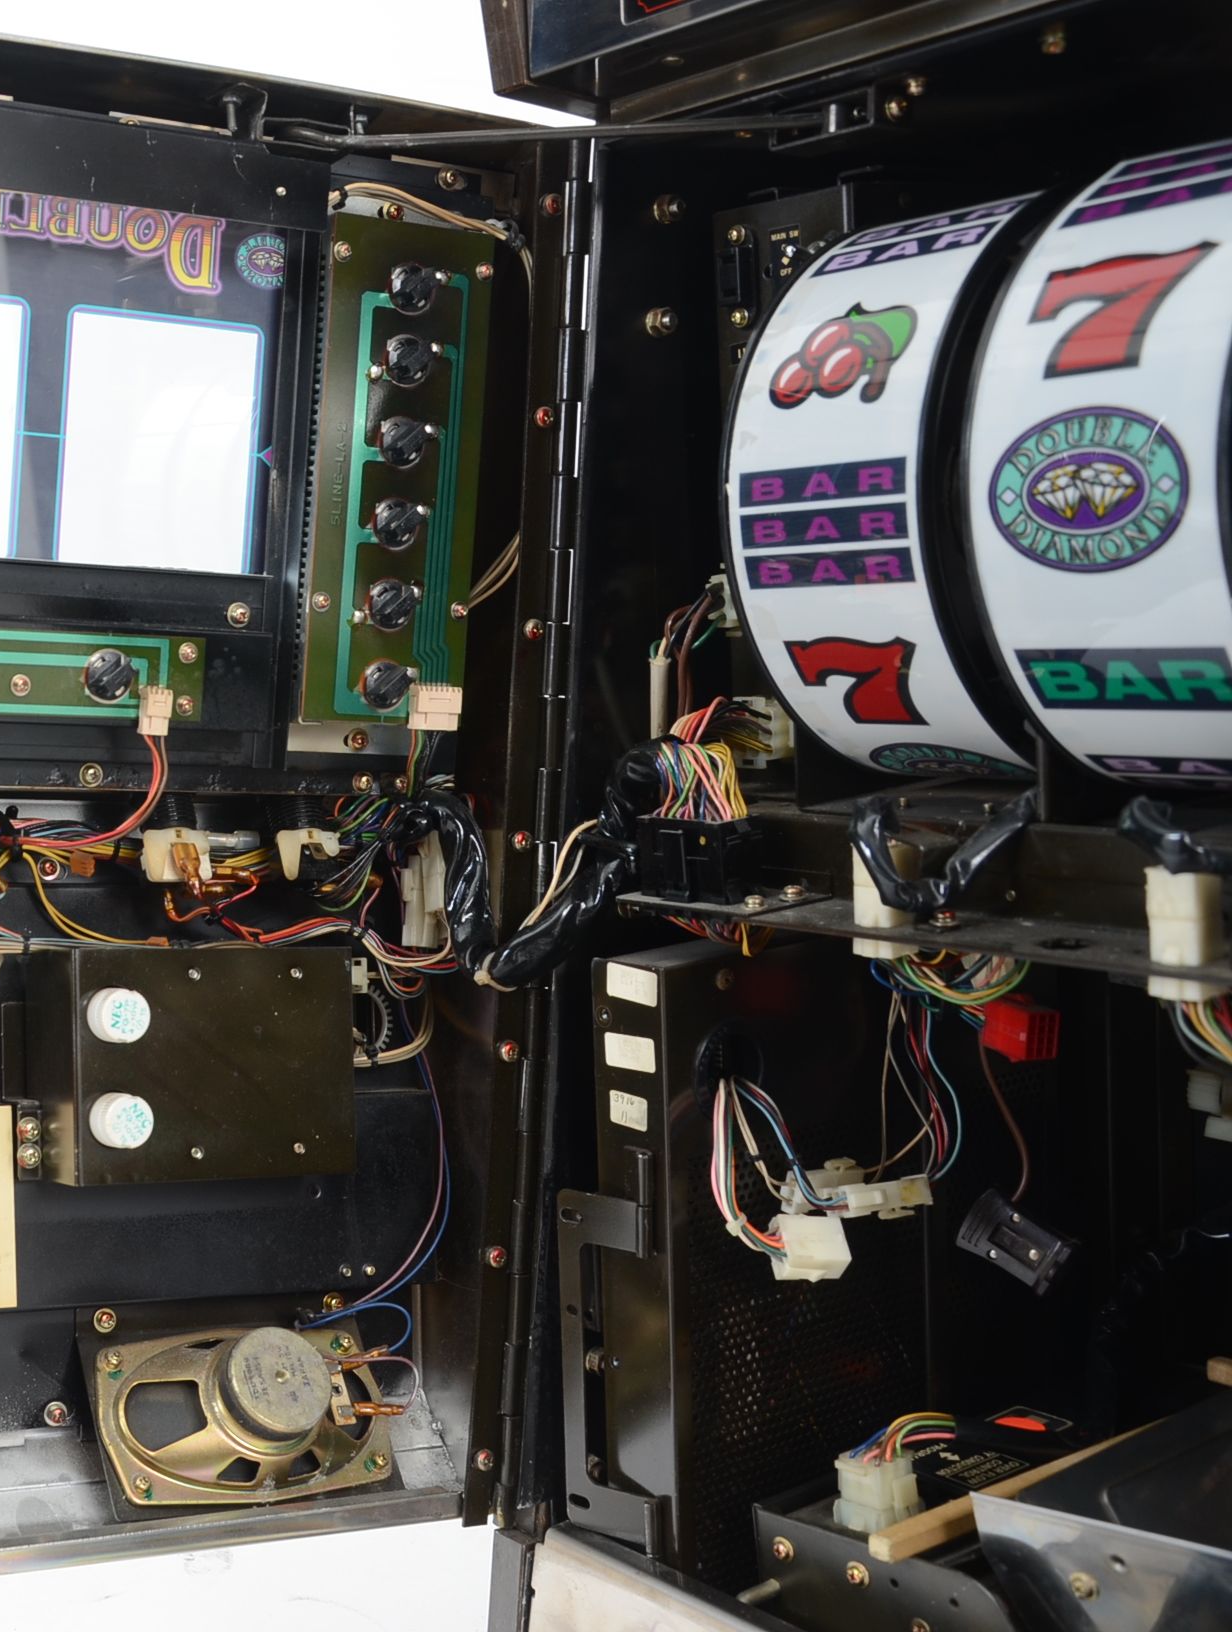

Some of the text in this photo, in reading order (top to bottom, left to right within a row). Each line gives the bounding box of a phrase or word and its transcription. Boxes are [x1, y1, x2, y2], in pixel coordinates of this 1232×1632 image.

[823, 226, 986, 272] BAR
[1027, 240, 1221, 380] 7
[1008, 415, 1164, 477] DOUBLE
[751, 466, 895, 501] BAR
[753, 511, 897, 544] BAR
[1007, 501, 1173, 563] DIAMOND
[758, 554, 903, 585] BAR
[783, 636, 930, 726] 7
[1029, 660, 1232, 702] BAR
